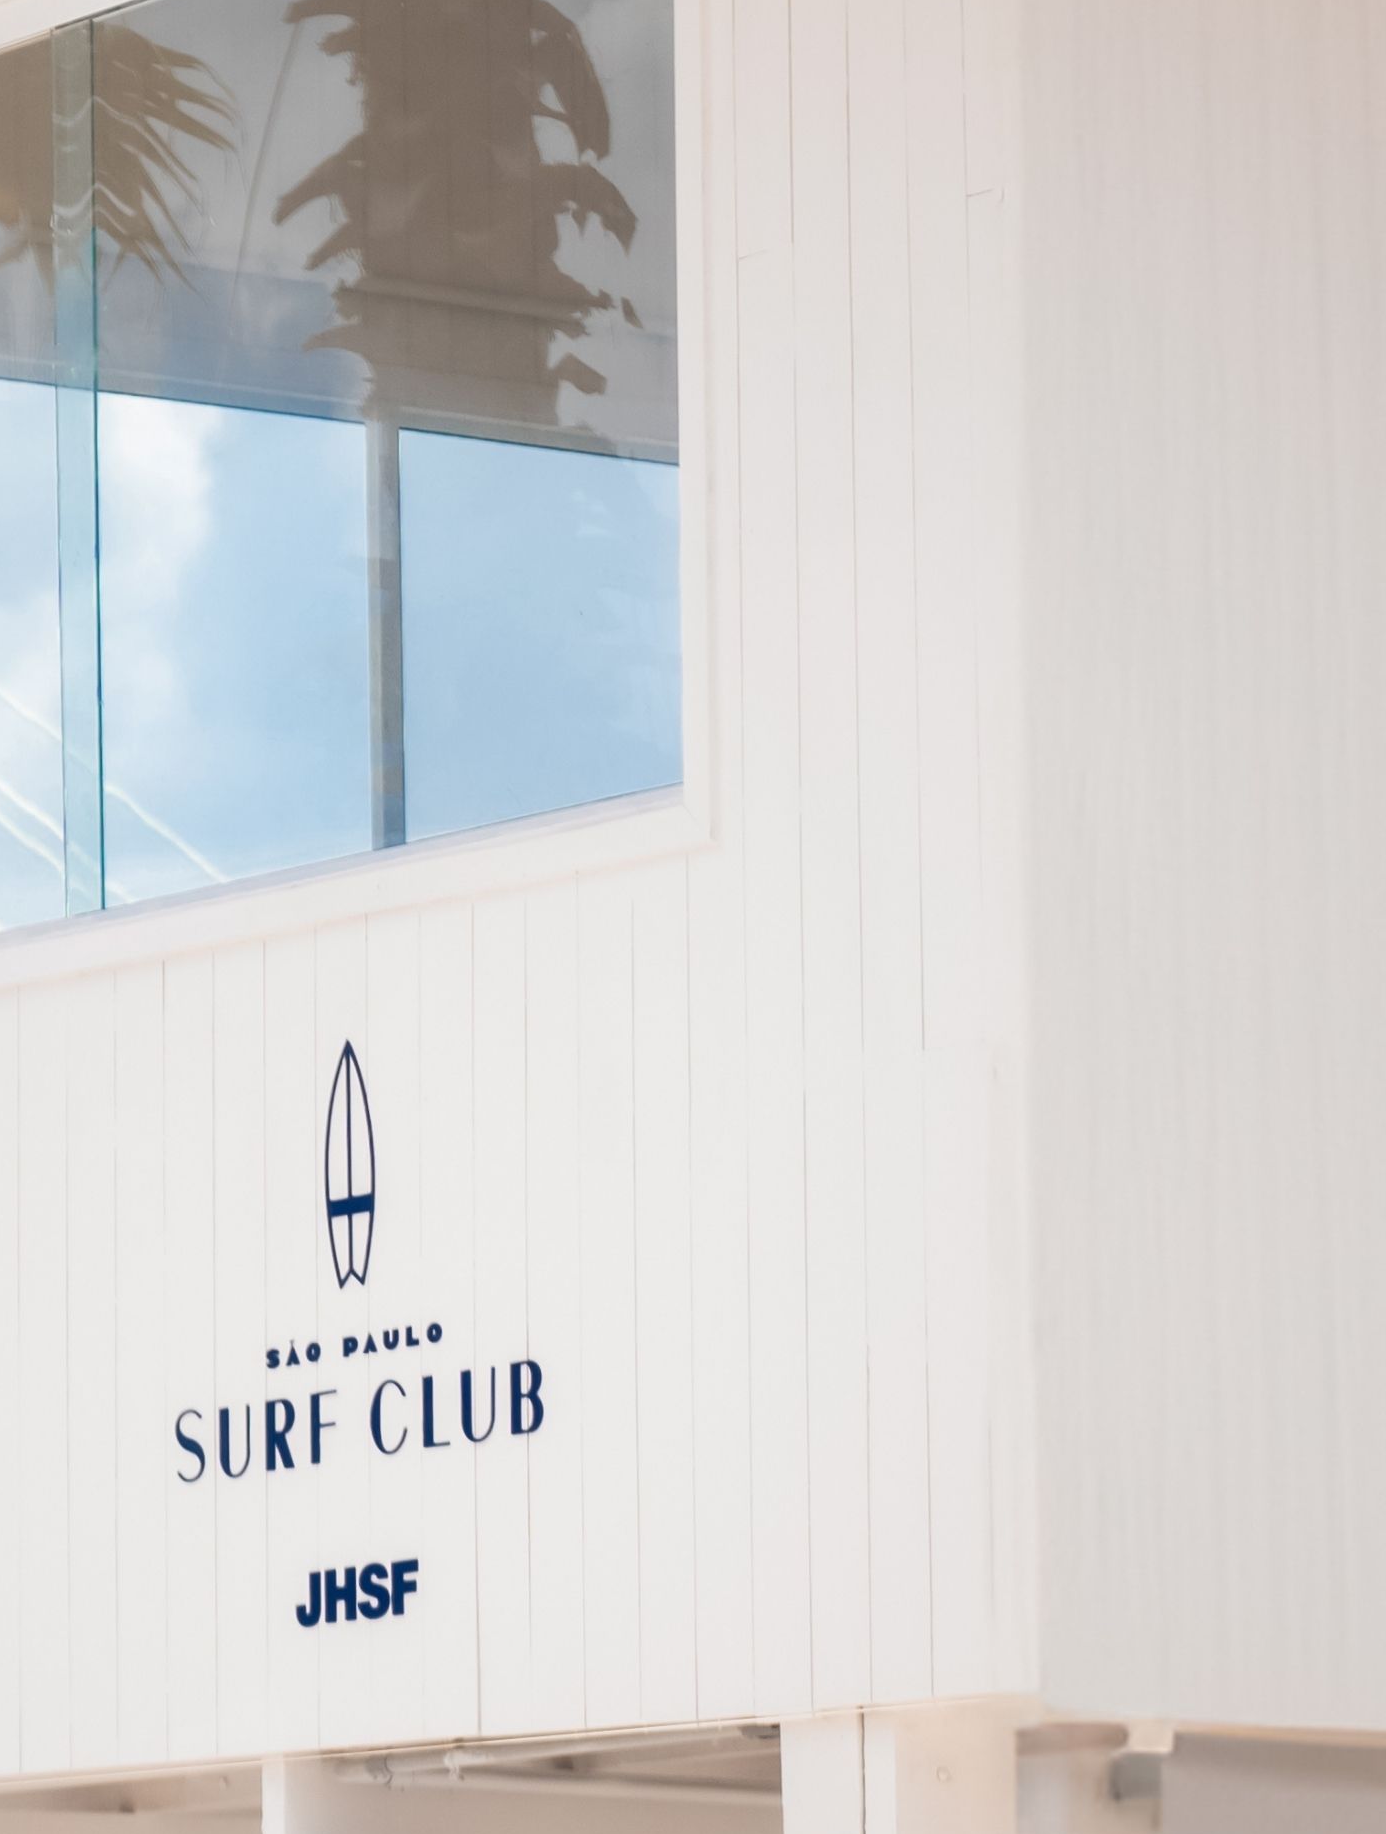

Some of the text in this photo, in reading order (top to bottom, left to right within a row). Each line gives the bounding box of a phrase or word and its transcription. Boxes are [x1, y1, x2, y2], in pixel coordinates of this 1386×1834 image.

[266, 1323, 443, 1369] SÃO PAULO
[174, 1358, 545, 1483] SURF CLUB
[295, 1559, 420, 1629] JHSF
